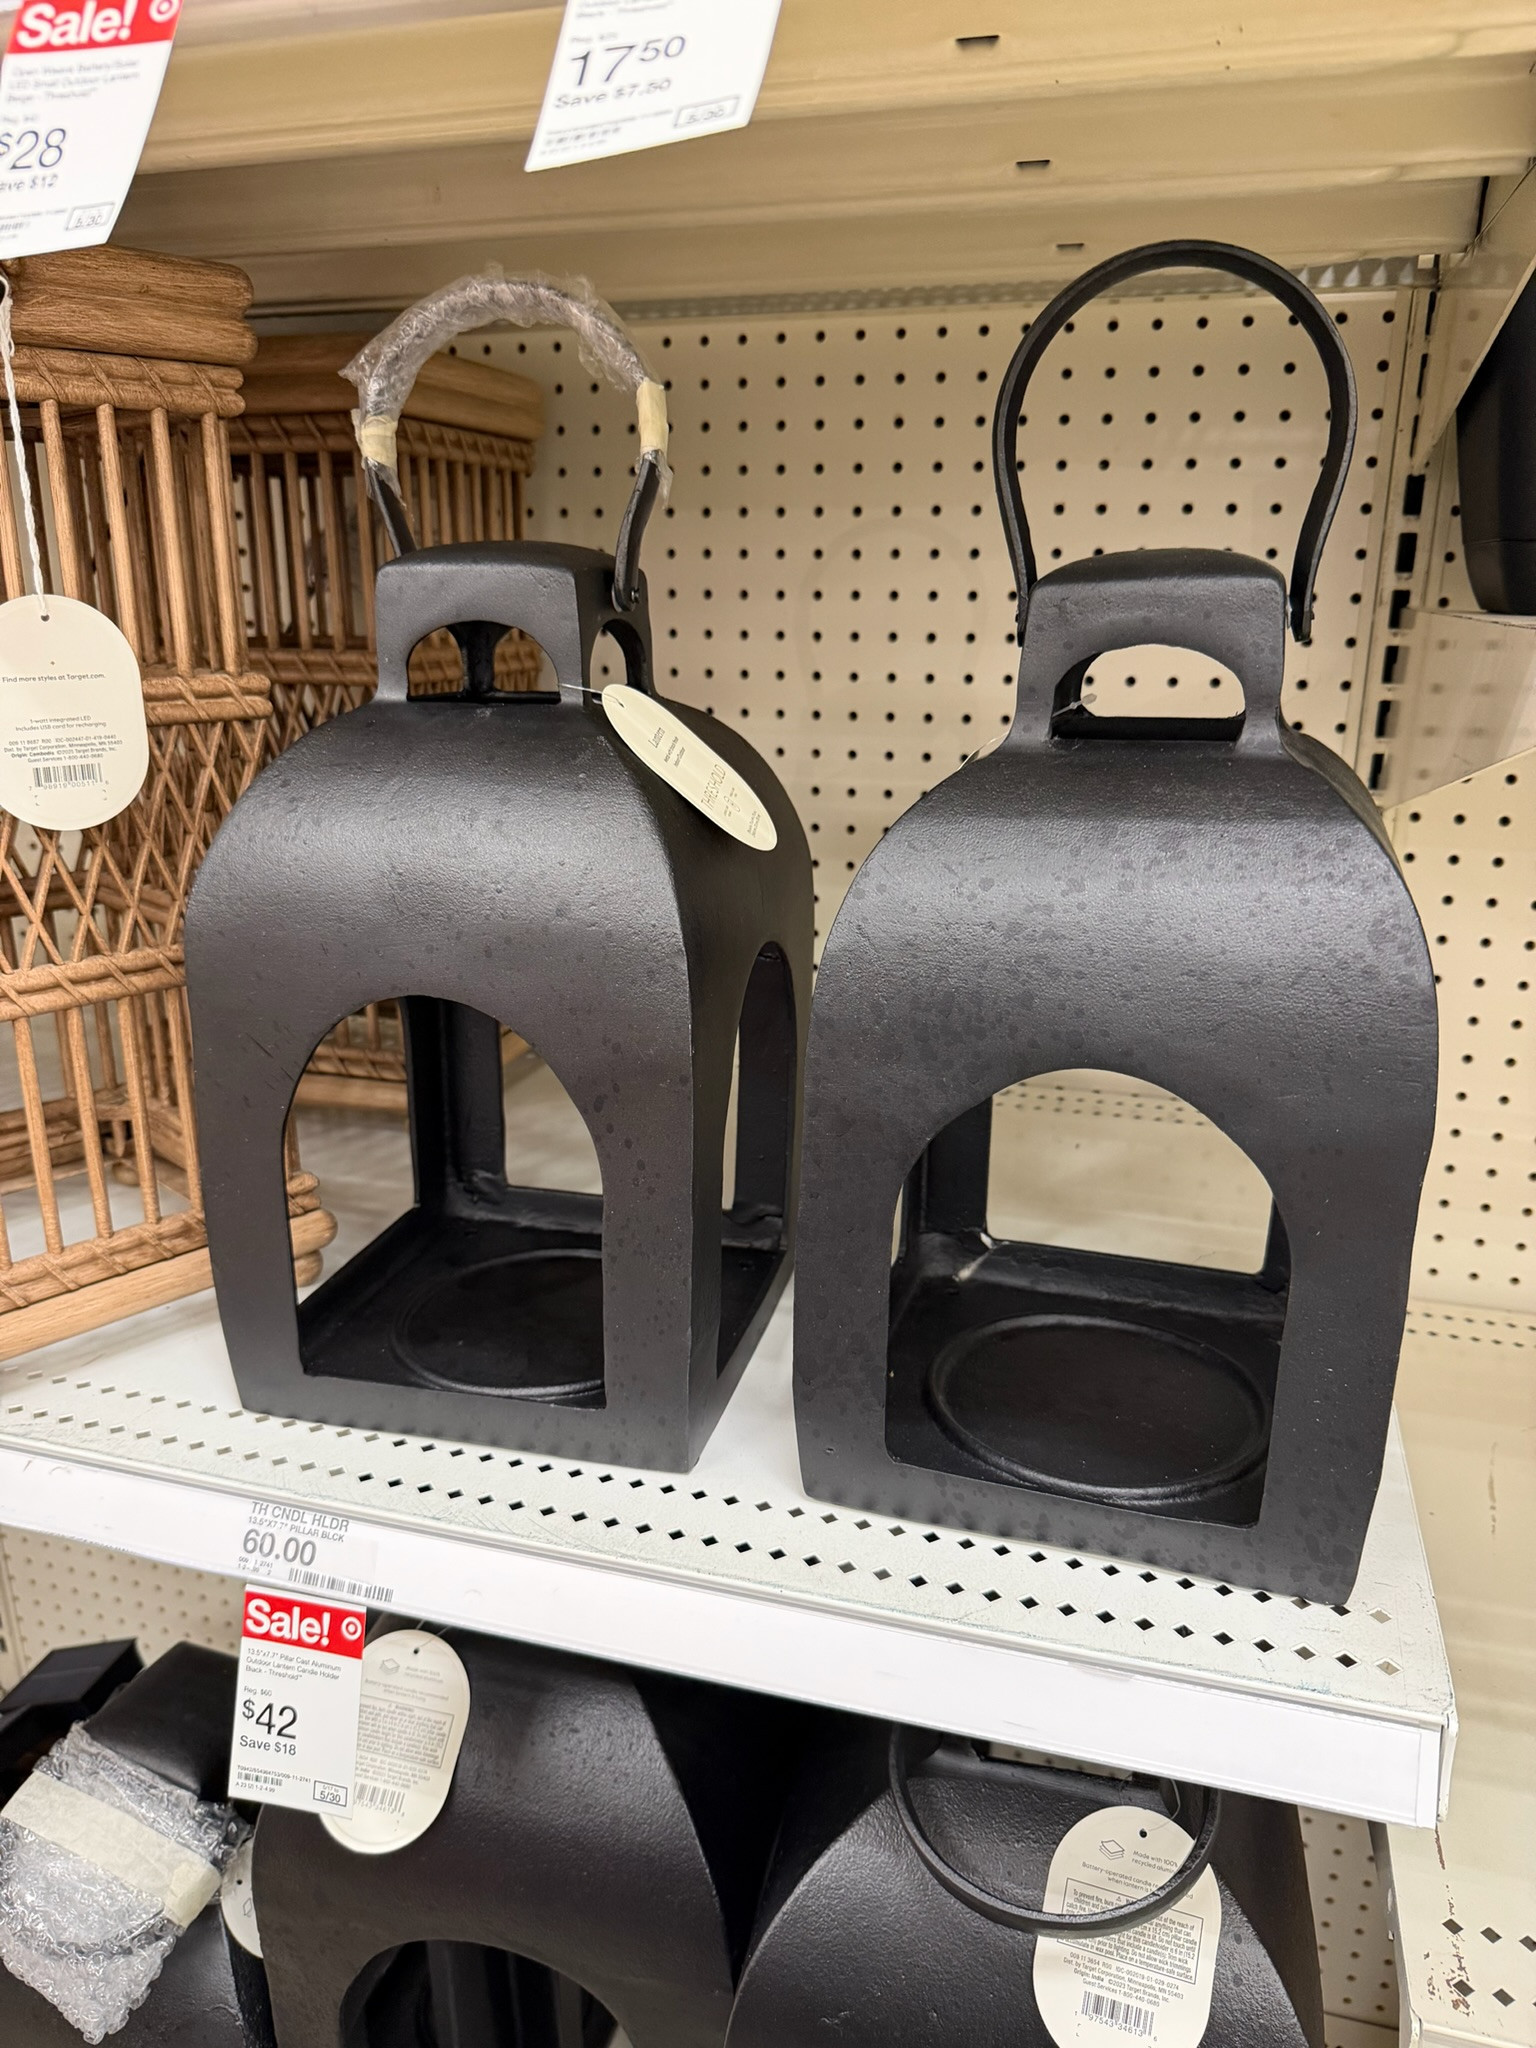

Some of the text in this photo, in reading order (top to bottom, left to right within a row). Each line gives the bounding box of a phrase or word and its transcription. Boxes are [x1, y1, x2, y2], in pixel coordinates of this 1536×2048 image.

[16, 0, 138, 48] Sale!
[555, 91, 607, 109] Save
[0, 181, 25, 191] ave
[252, 1501, 350, 1533] TH CNDL HLDR
[290, 1524, 319, 1538] PILLAR
[321, 1530, 345, 1543] BLCK
[243, 1528, 317, 1567] 60.00
[245, 1598, 331, 1647] Sale!
[245, 1665, 262, 1674] Black
[246, 1656, 340, 1680] Outdoor Lantern Candle Holder
[280, 1653, 295, 1662] Pillar
[296, 1656, 310, 1666] Cast
[311, 1660, 342, 1672] Aluminum
[241, 1697, 298, 1740] $42
[239, 1735, 297, 1756] Save $18
[319, 1790, 341, 1803] 5/30
[1131, 1858, 1156, 1870] recycled
[1133, 1850, 1150, 1859] Made
[1150, 1854, 1163, 1863] with
[1082, 1861, 1152, 1887] Battery-operated candle
[1122, 1879, 1144, 1890] lantern
[1176, 1919, 1189, 1928] reach
[1063, 1956, 1074, 1965] Dist.
[1074, 1960, 1082, 1968] by
[1082, 1962, 1097, 1974] Target
[1157, 1986, 1167, 1994] MN
[1073, 1968, 1170, 2003] Origin: India ©2023 Target Brands, Inc.
[1083, 1978, 1096, 1987] Guest
[1096, 1981, 1118, 1994] Services
[1088, 2014, 1114, 2028] 97543
[1117, 2023, 1144, 2038] 34613
